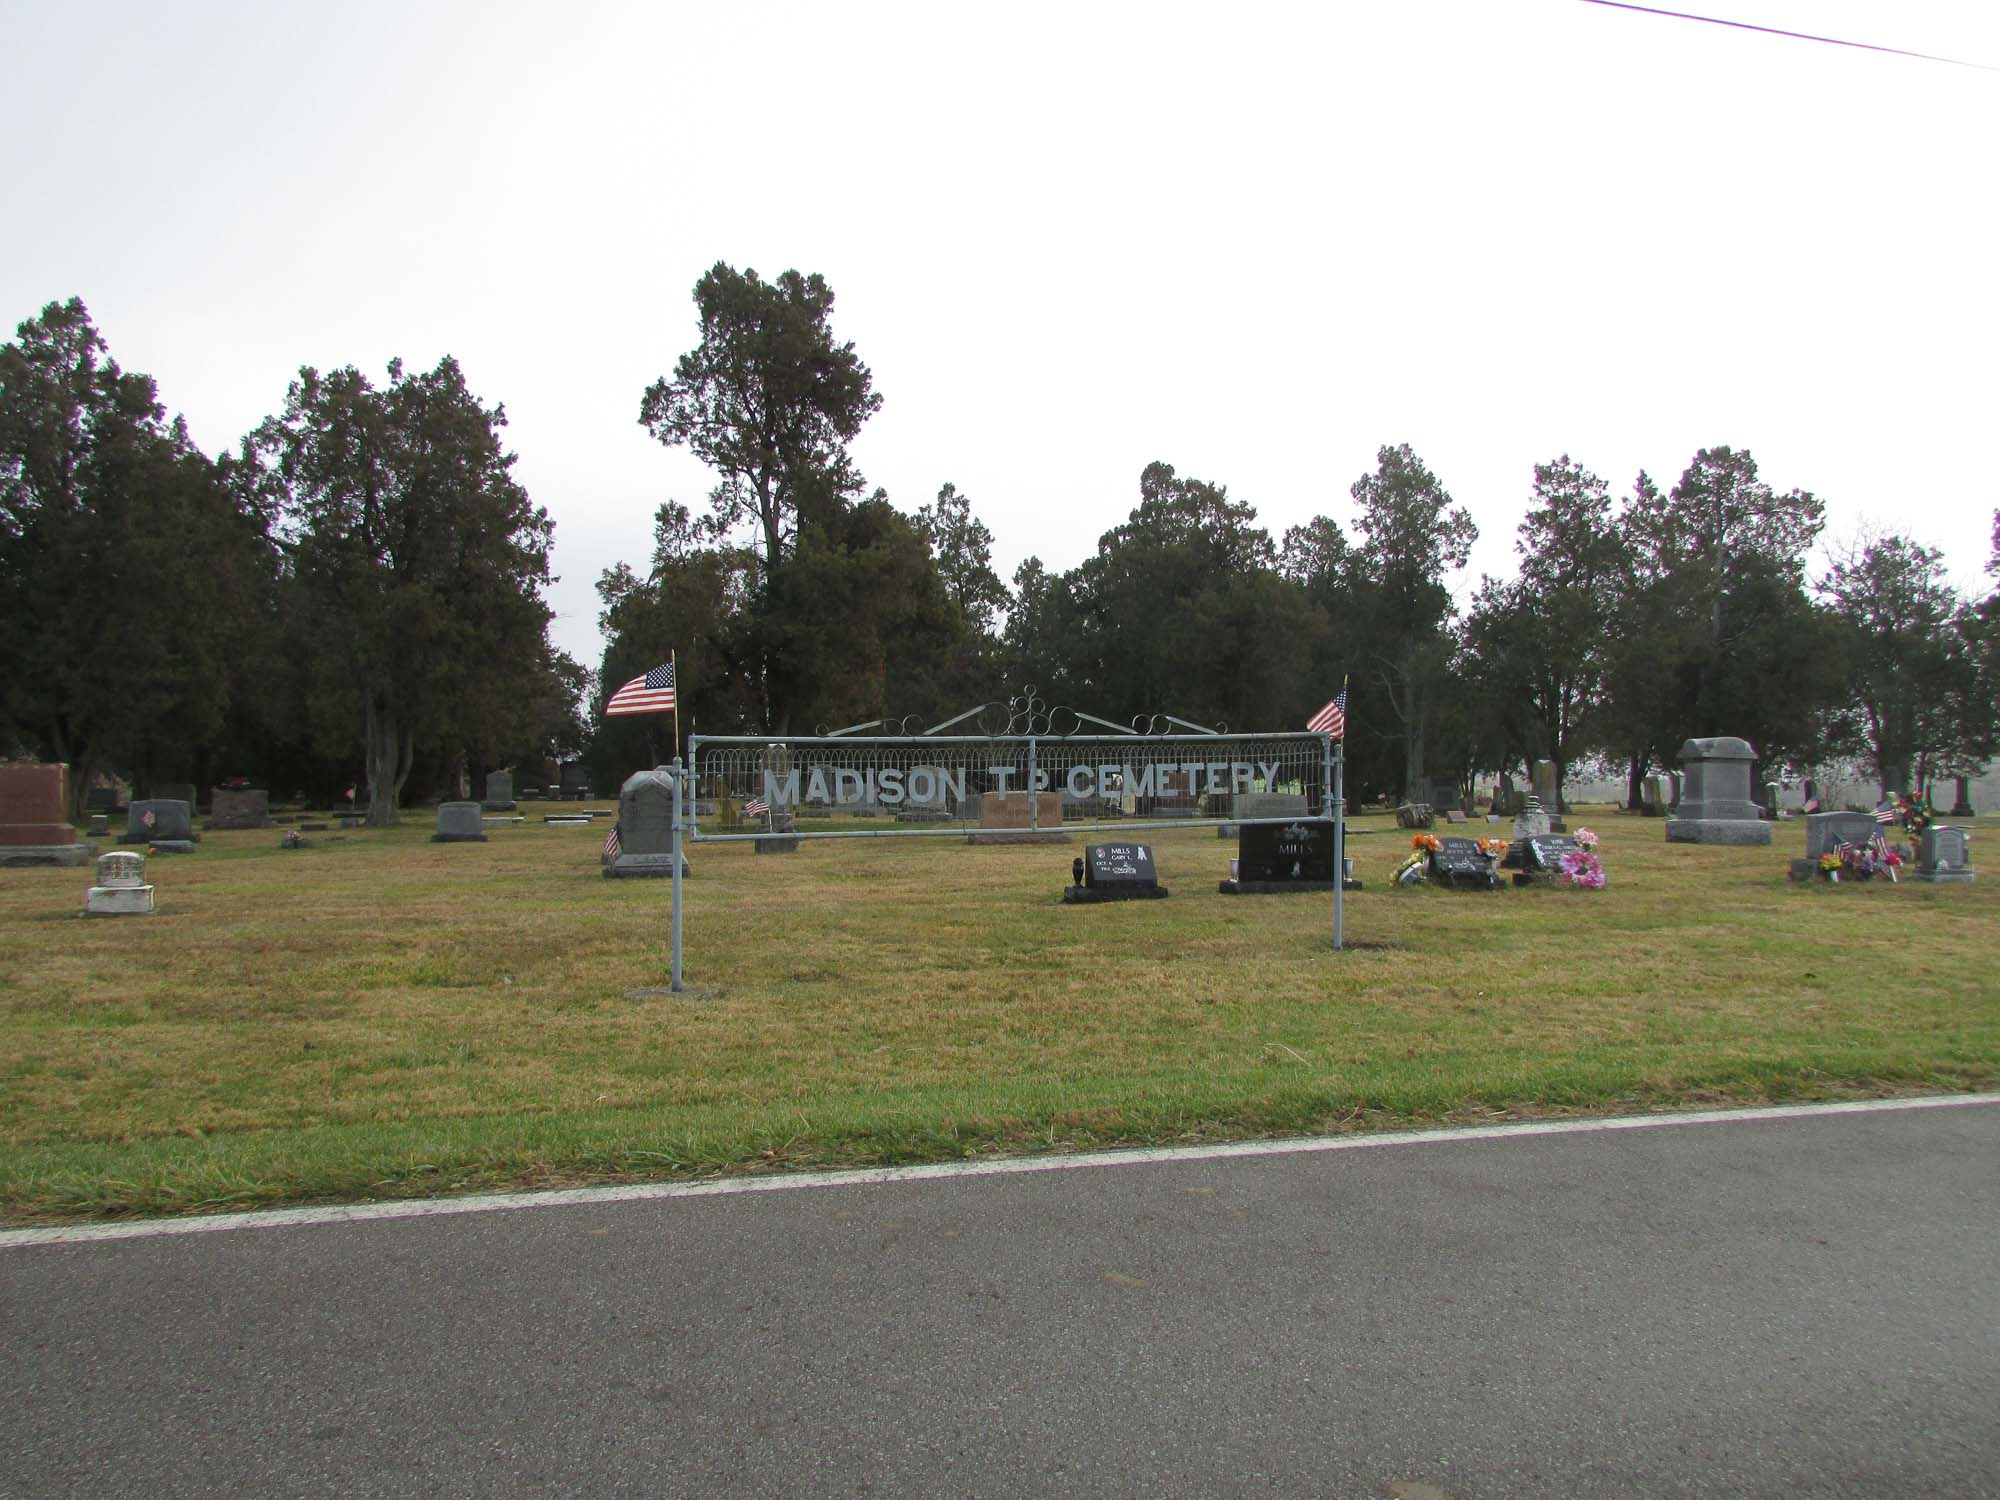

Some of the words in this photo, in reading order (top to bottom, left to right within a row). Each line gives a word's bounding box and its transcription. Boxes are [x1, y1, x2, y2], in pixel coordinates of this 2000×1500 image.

[764, 766, 966, 804] MADISON
[1067, 761, 1281, 799] CEMETERY
[1111, 847, 1131, 855] MILLS
[1278, 843, 1313, 855] MILLS
